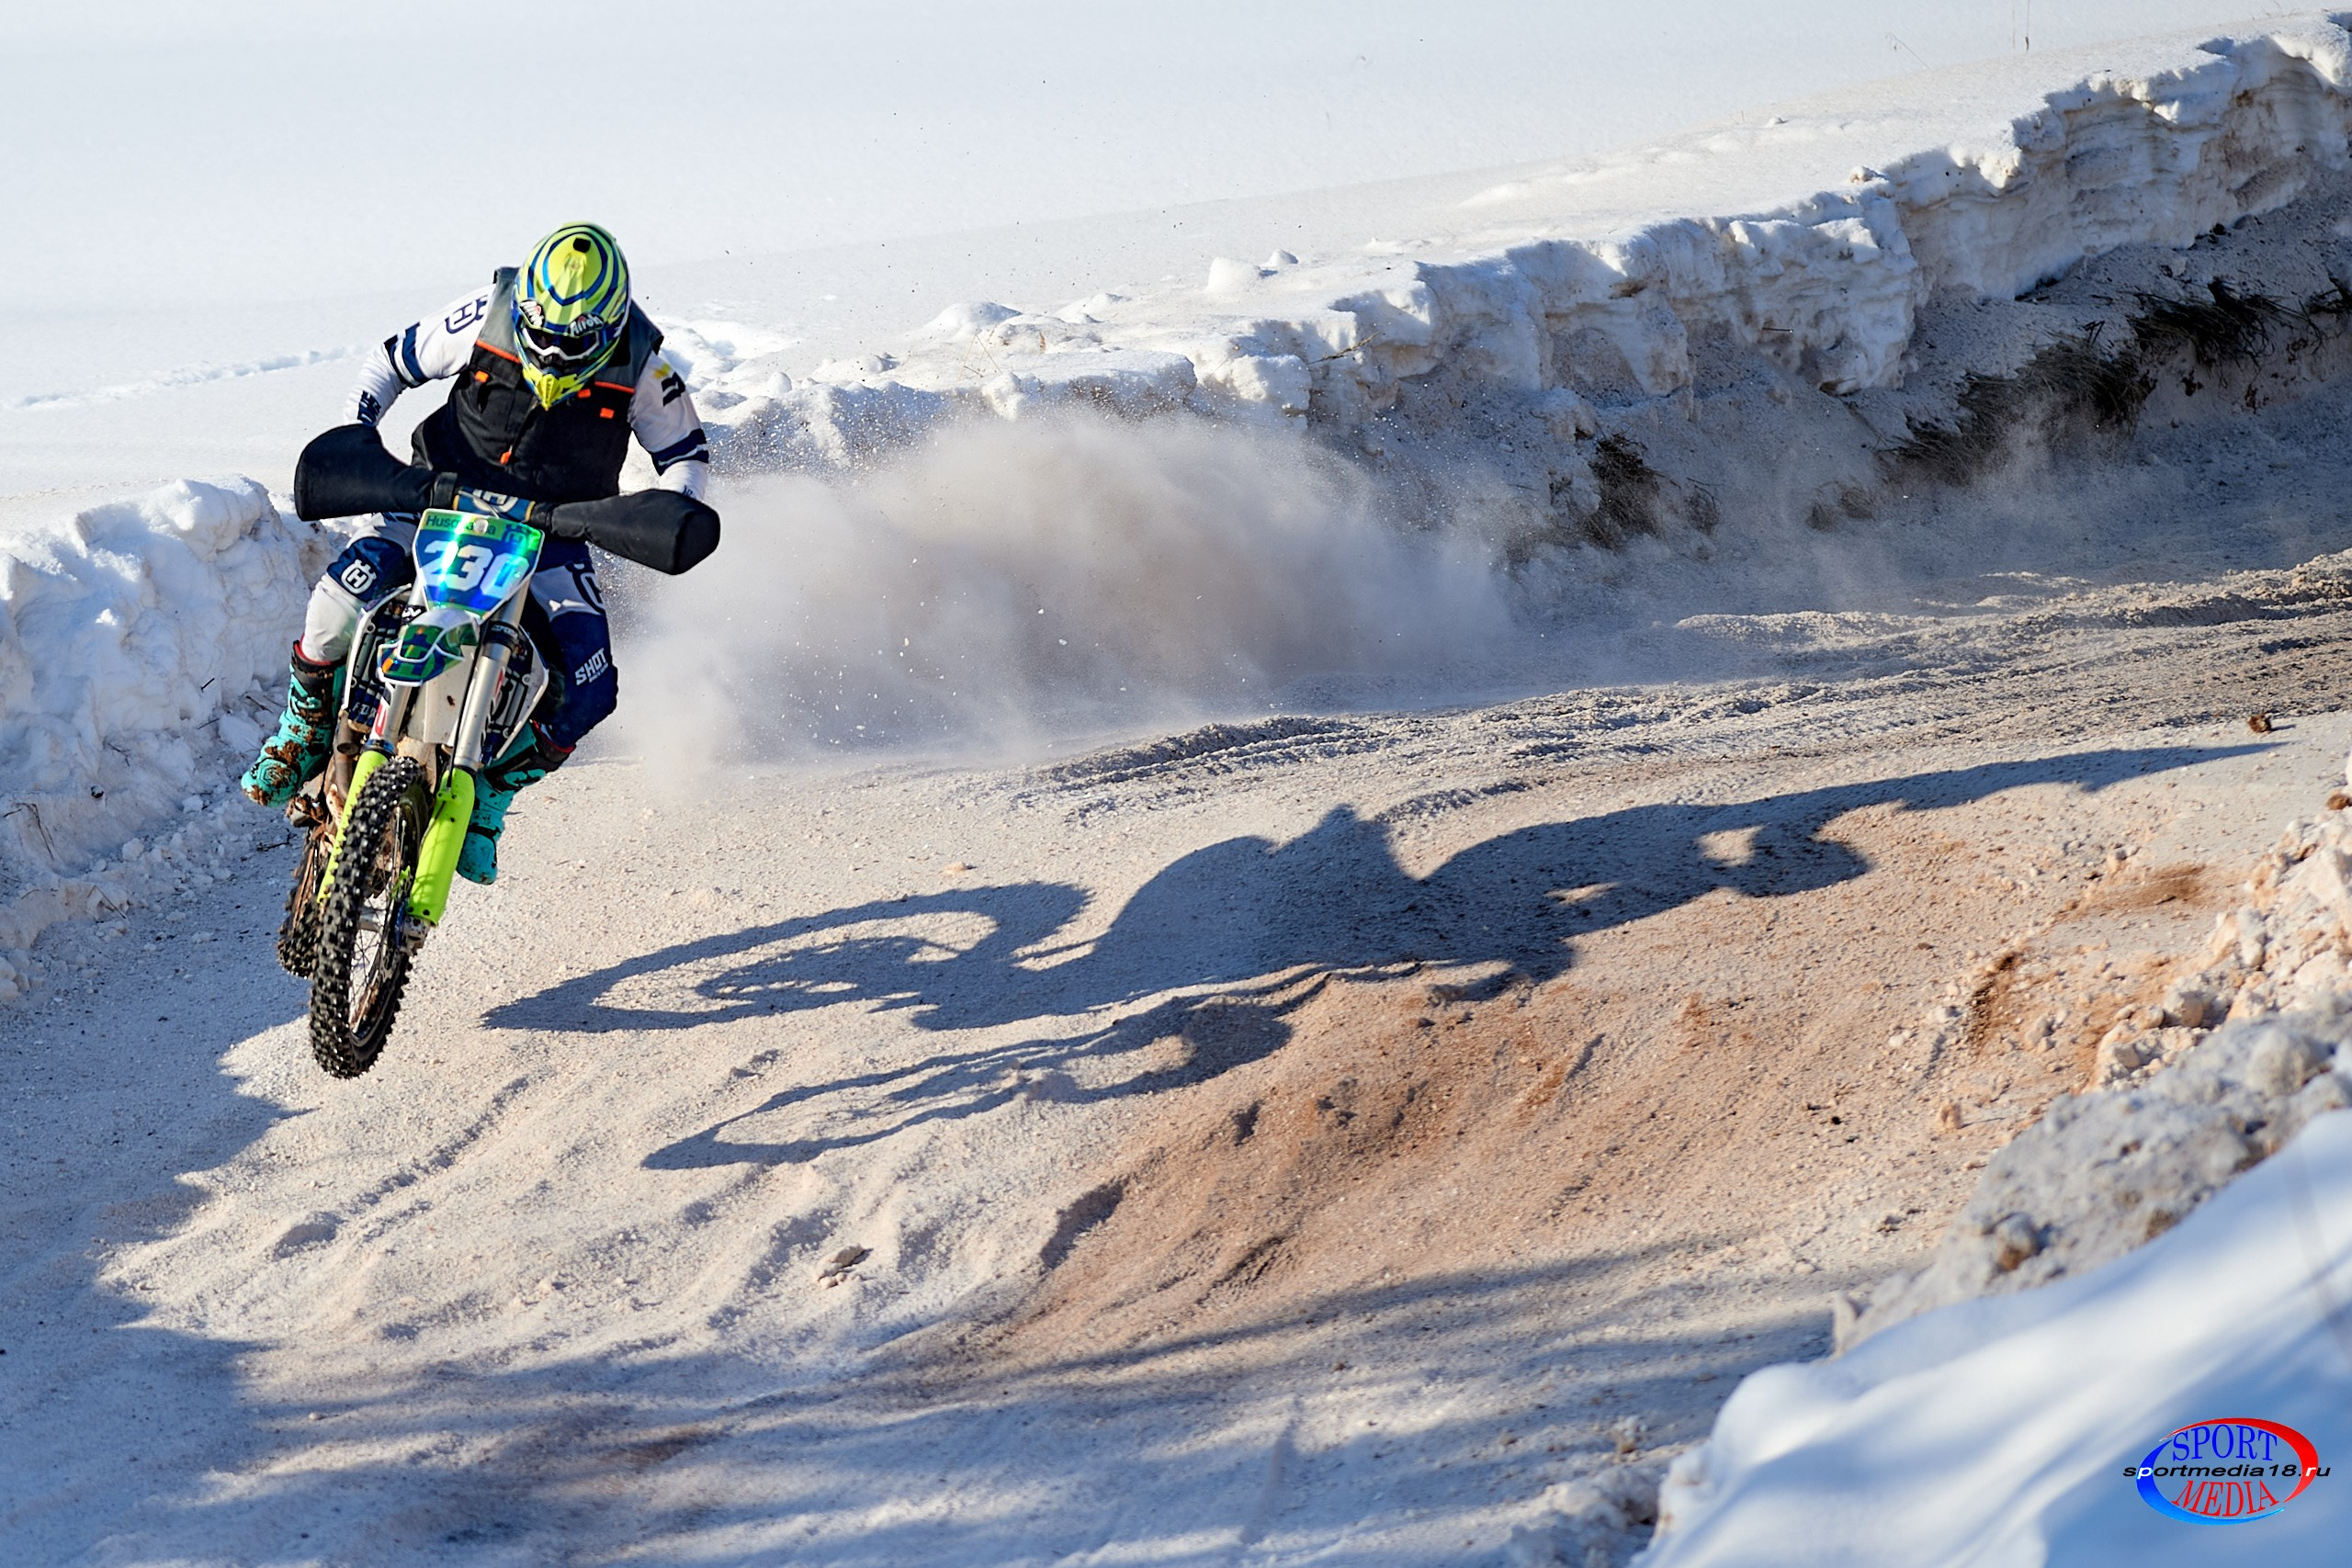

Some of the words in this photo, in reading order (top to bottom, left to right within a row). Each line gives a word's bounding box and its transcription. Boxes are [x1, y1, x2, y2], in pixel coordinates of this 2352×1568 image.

[426, 514, 496, 536] Husqaa
[418, 540, 530, 599] 230
[574, 647, 606, 686] SHOT
